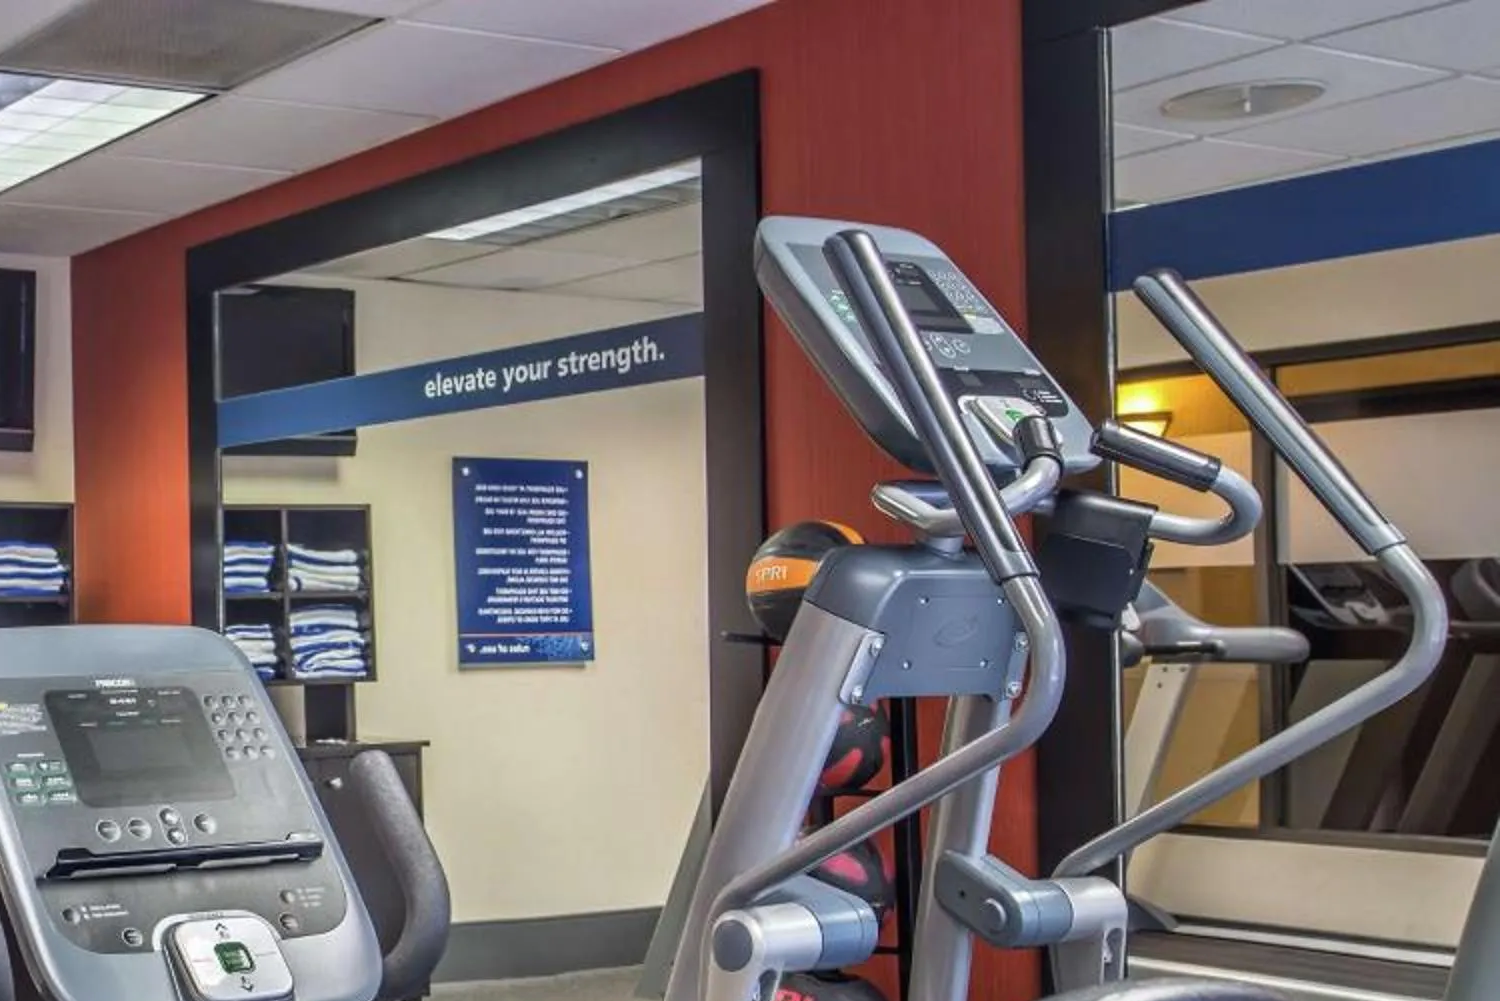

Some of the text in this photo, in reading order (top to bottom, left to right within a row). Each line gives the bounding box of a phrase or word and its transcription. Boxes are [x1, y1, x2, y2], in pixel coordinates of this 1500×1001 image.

[424, 336, 665, 398] elevate your strength.
